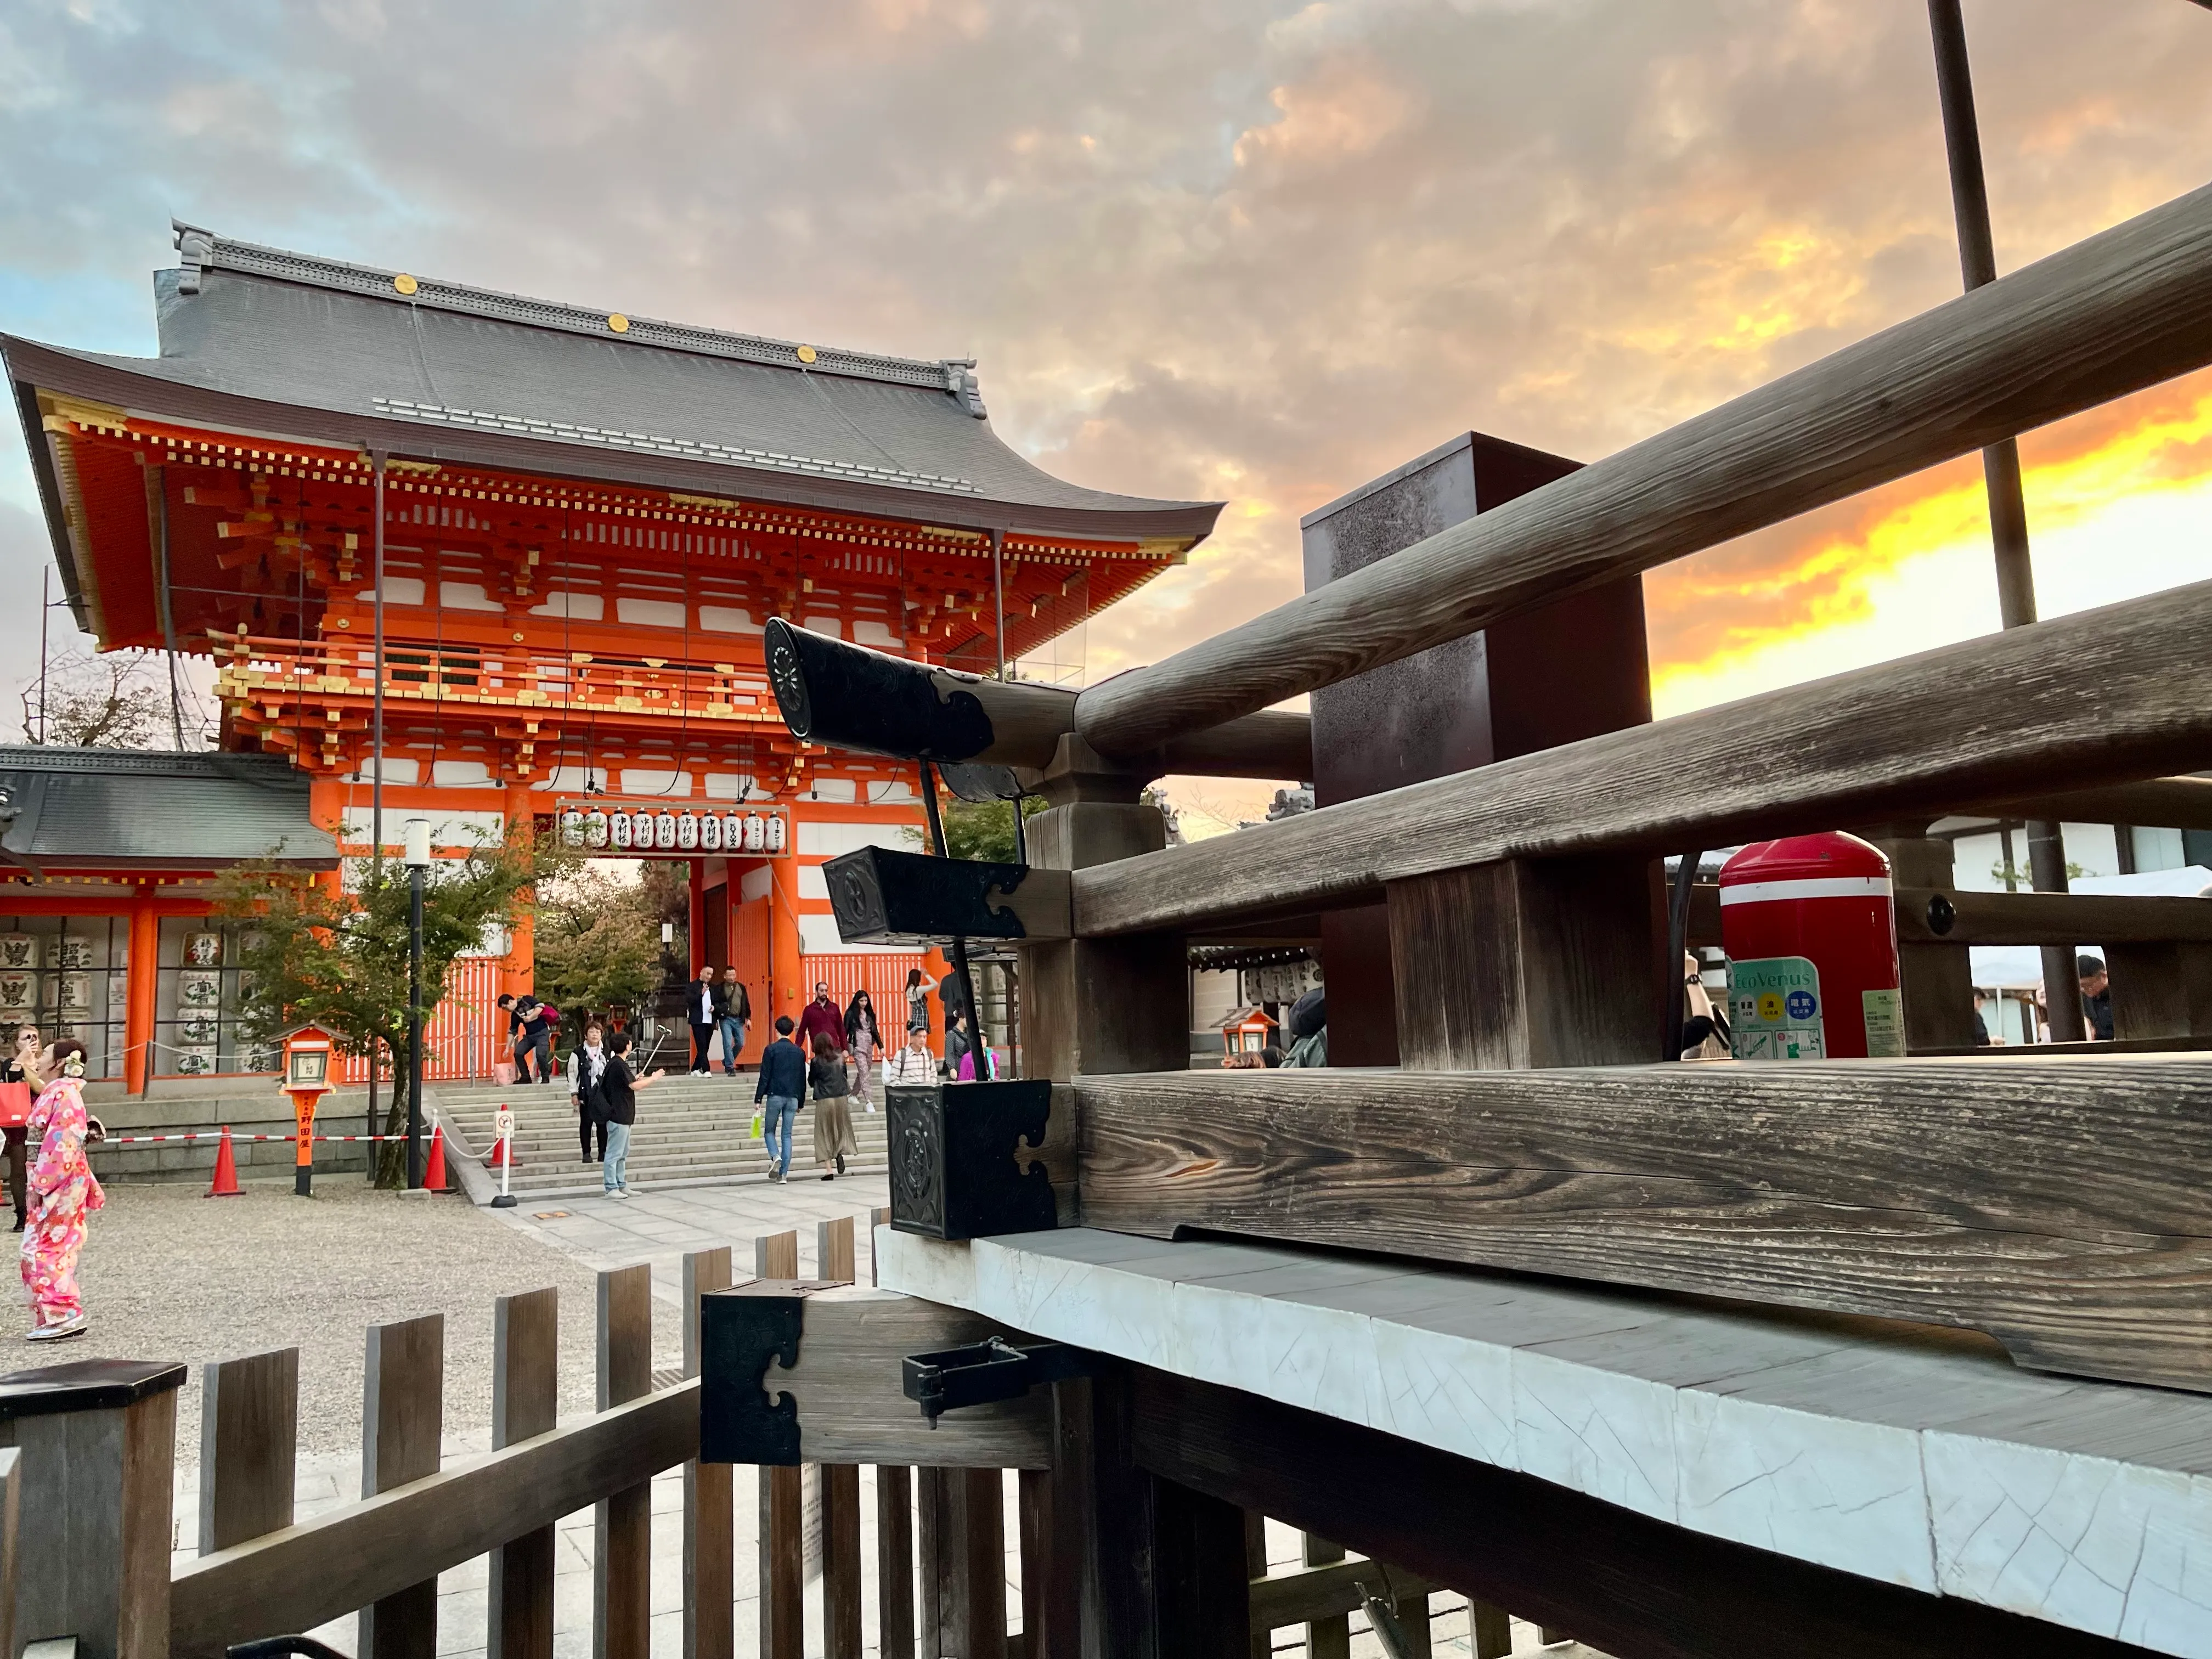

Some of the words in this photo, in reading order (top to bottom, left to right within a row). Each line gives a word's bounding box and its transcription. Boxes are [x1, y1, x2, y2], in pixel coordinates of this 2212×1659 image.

[1735, 972, 1811, 989] EcoVenus
[300, 1115, 312, 1148] 野田屋
